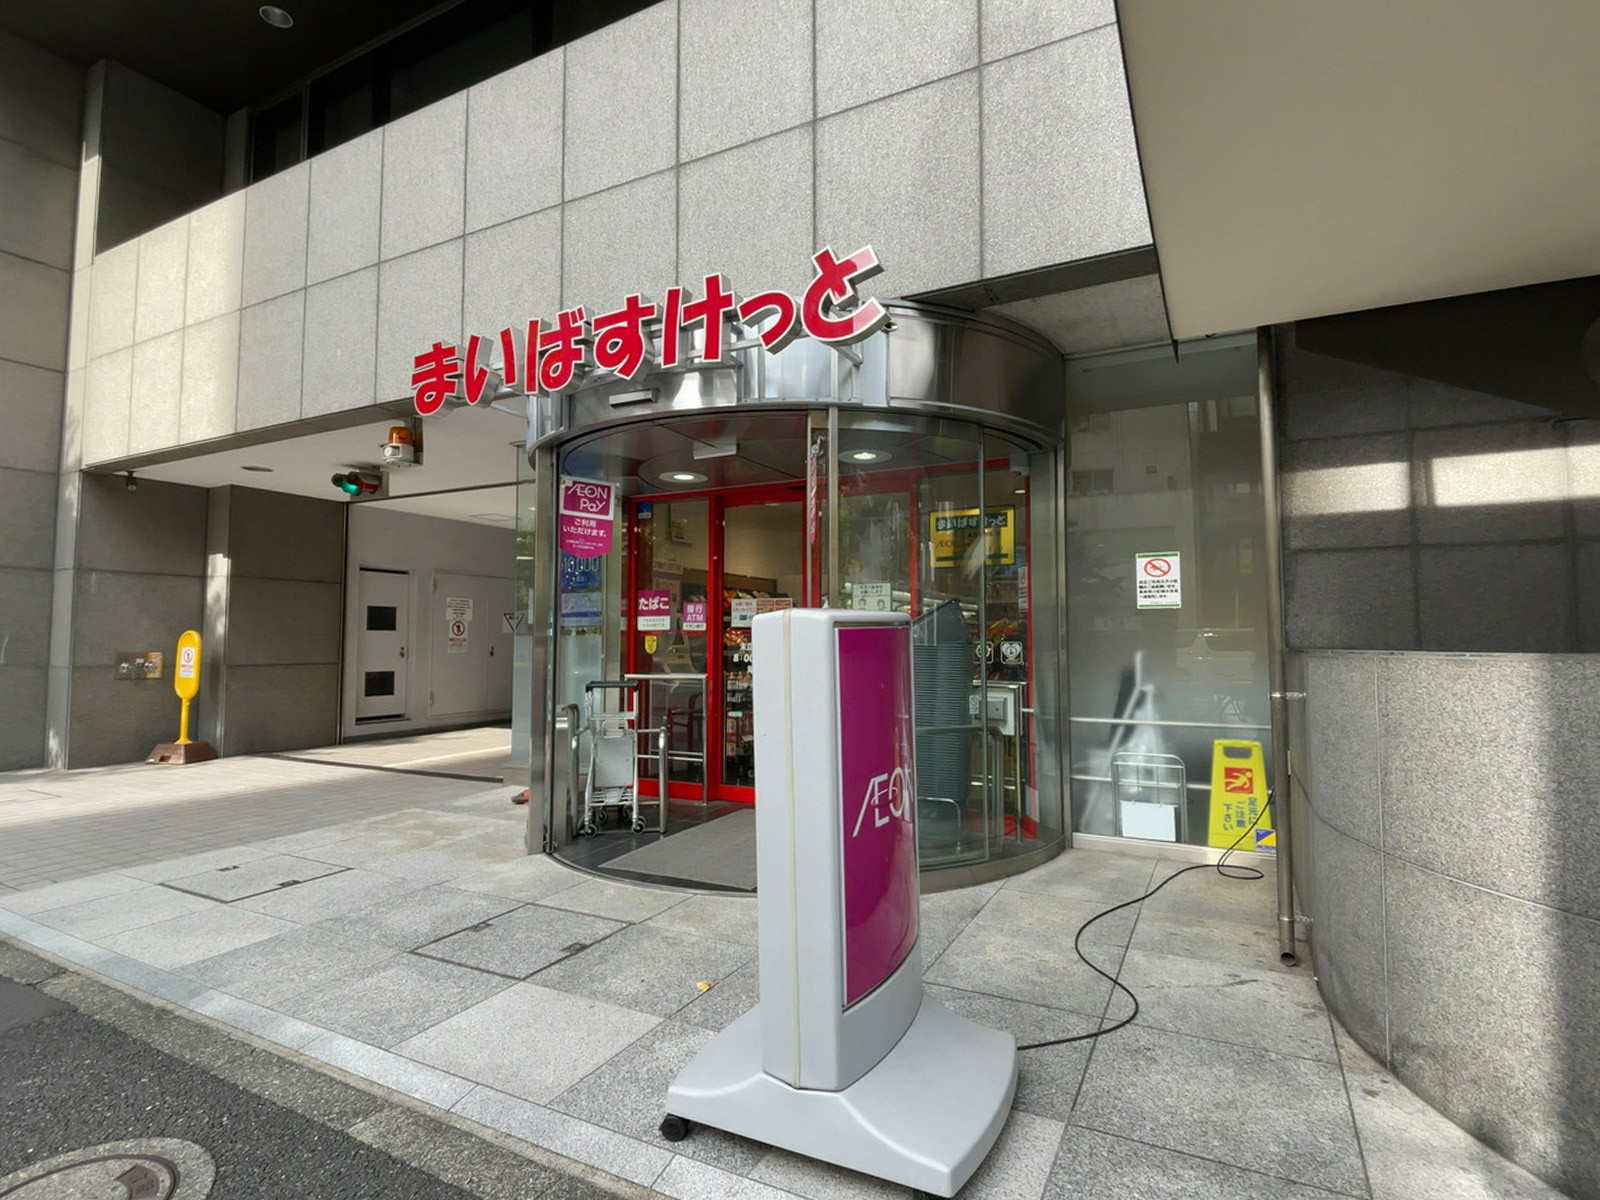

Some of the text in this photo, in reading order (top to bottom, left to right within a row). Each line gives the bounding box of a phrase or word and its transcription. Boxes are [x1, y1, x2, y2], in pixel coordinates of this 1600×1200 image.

[411, 244, 890, 416] まいばすけっと
[580, 498, 606, 512] Pay
[574, 518, 597, 528] ご利用
[937, 515, 1006, 529] まいばすっと
[638, 596, 670, 610] たばこ
[686, 604, 703, 613] 銀行
[686, 613, 704, 622] ATM
